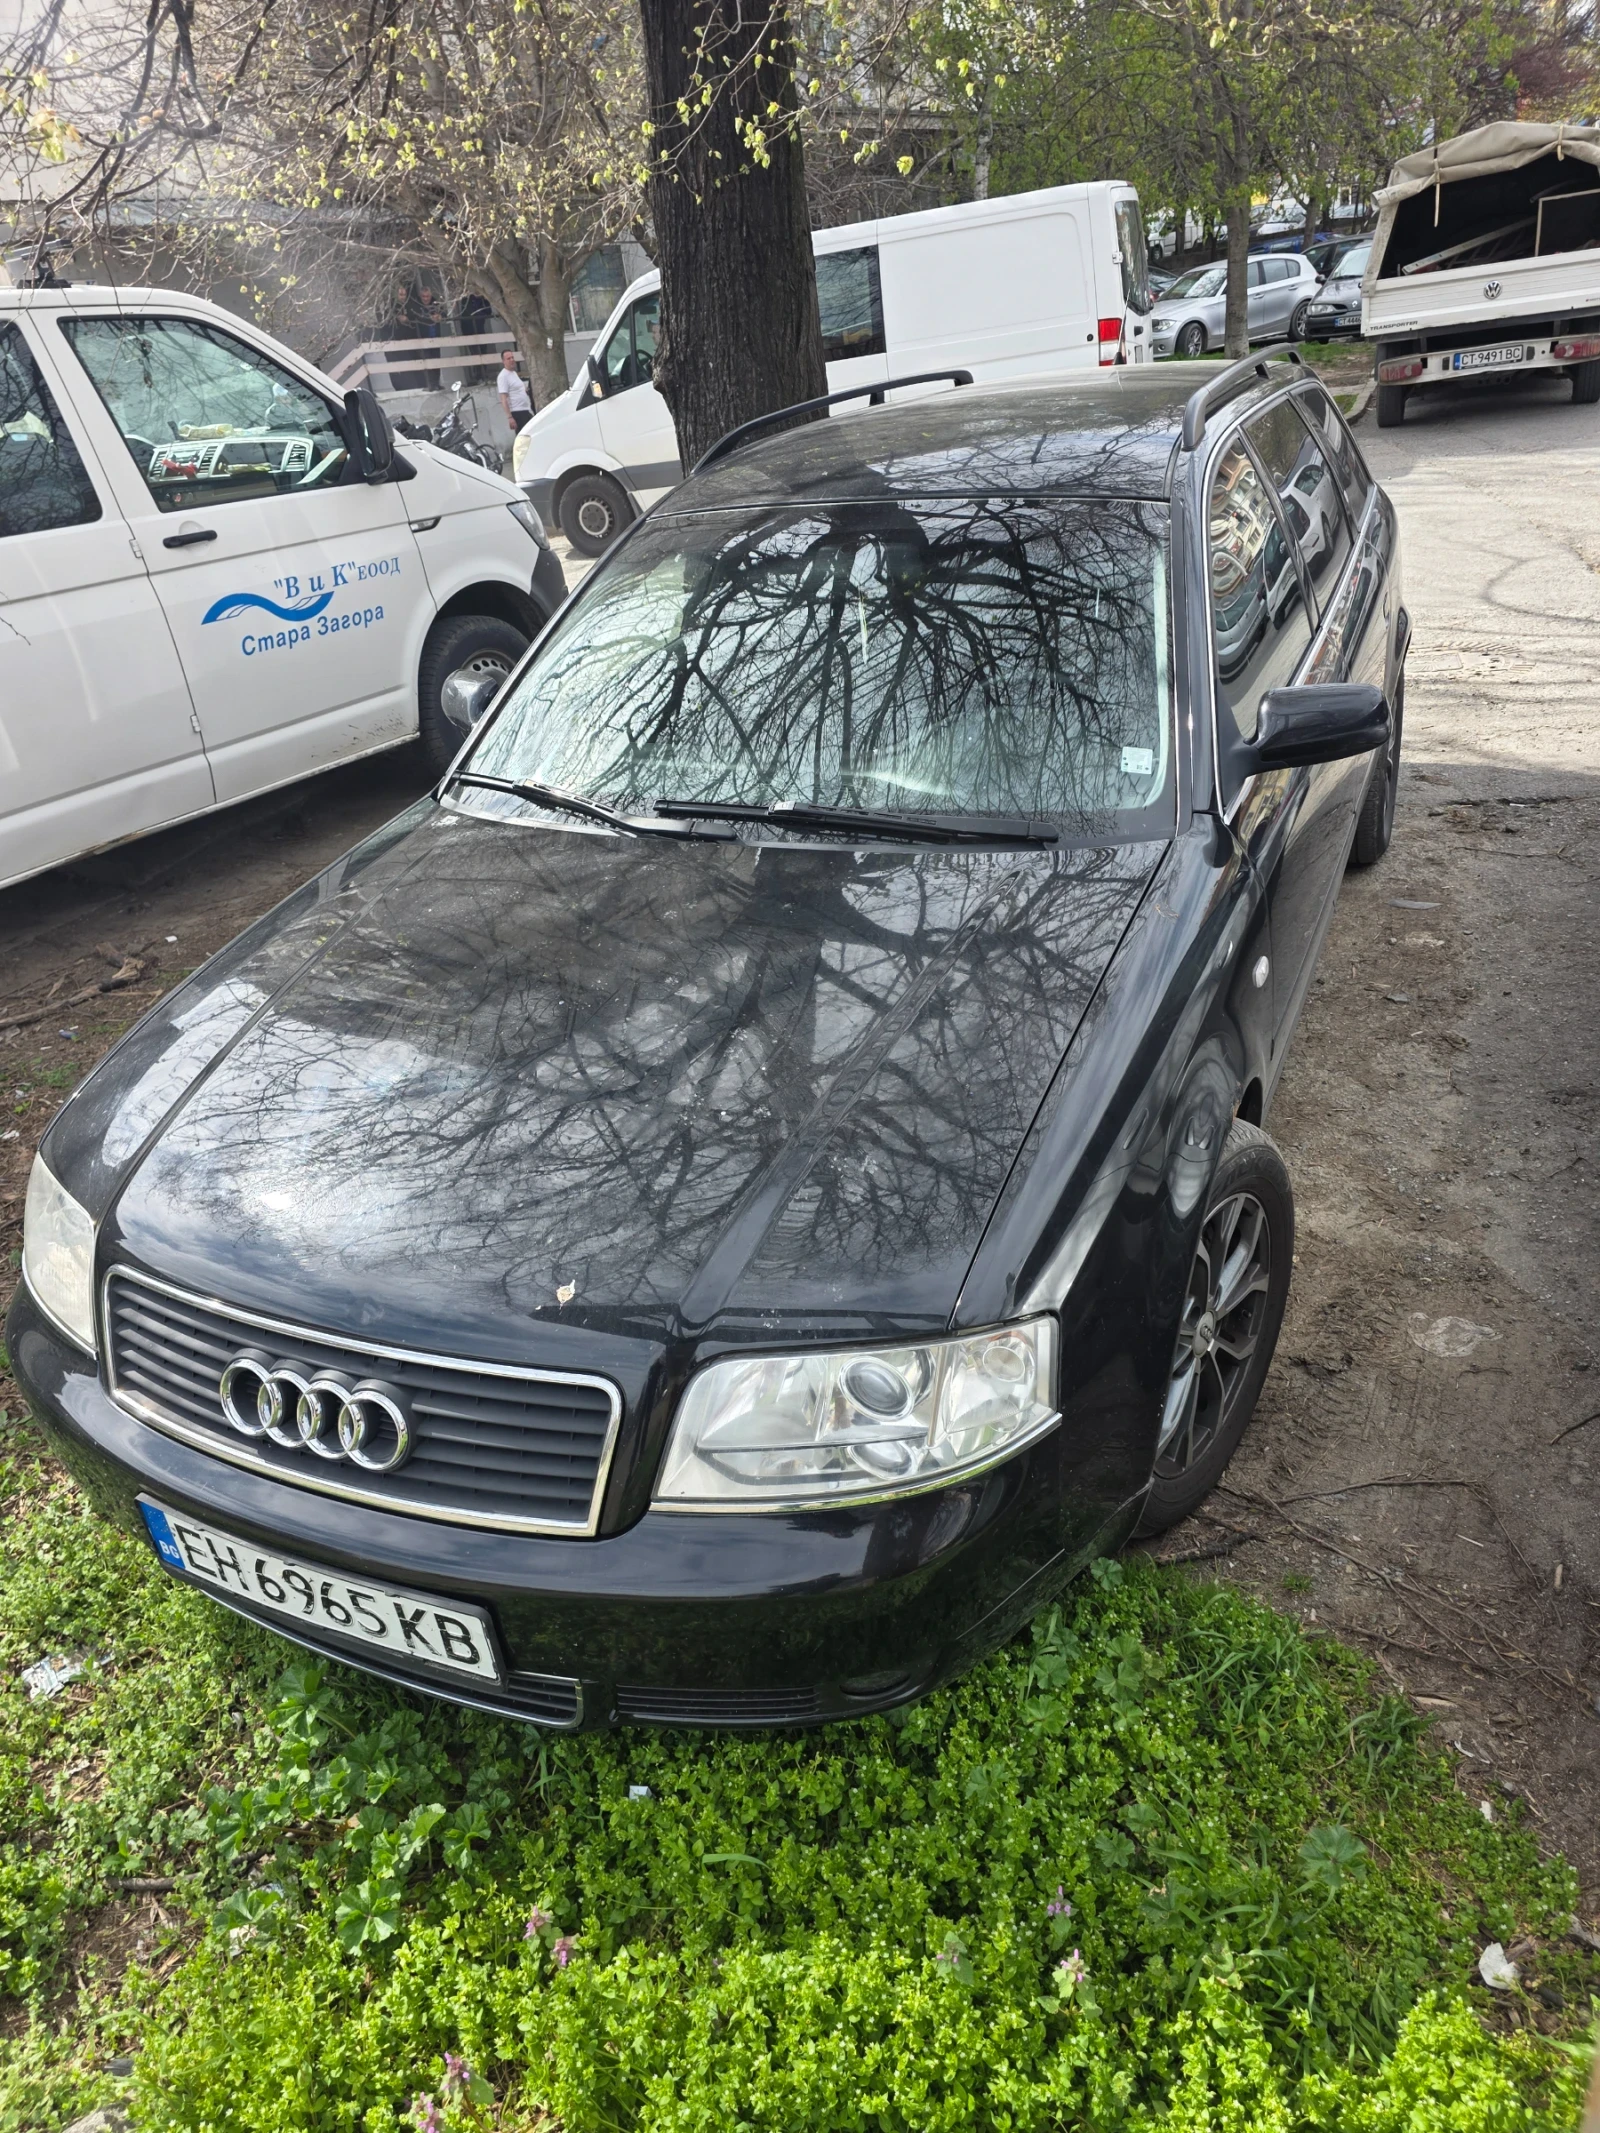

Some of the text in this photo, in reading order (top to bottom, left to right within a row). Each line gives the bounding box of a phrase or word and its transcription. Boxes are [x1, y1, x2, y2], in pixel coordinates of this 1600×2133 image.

[1369, 320, 1419, 331] TRANSPORTER
[241, 605, 384, 656] Стара Загора
[159, 1540, 180, 1559] BG
